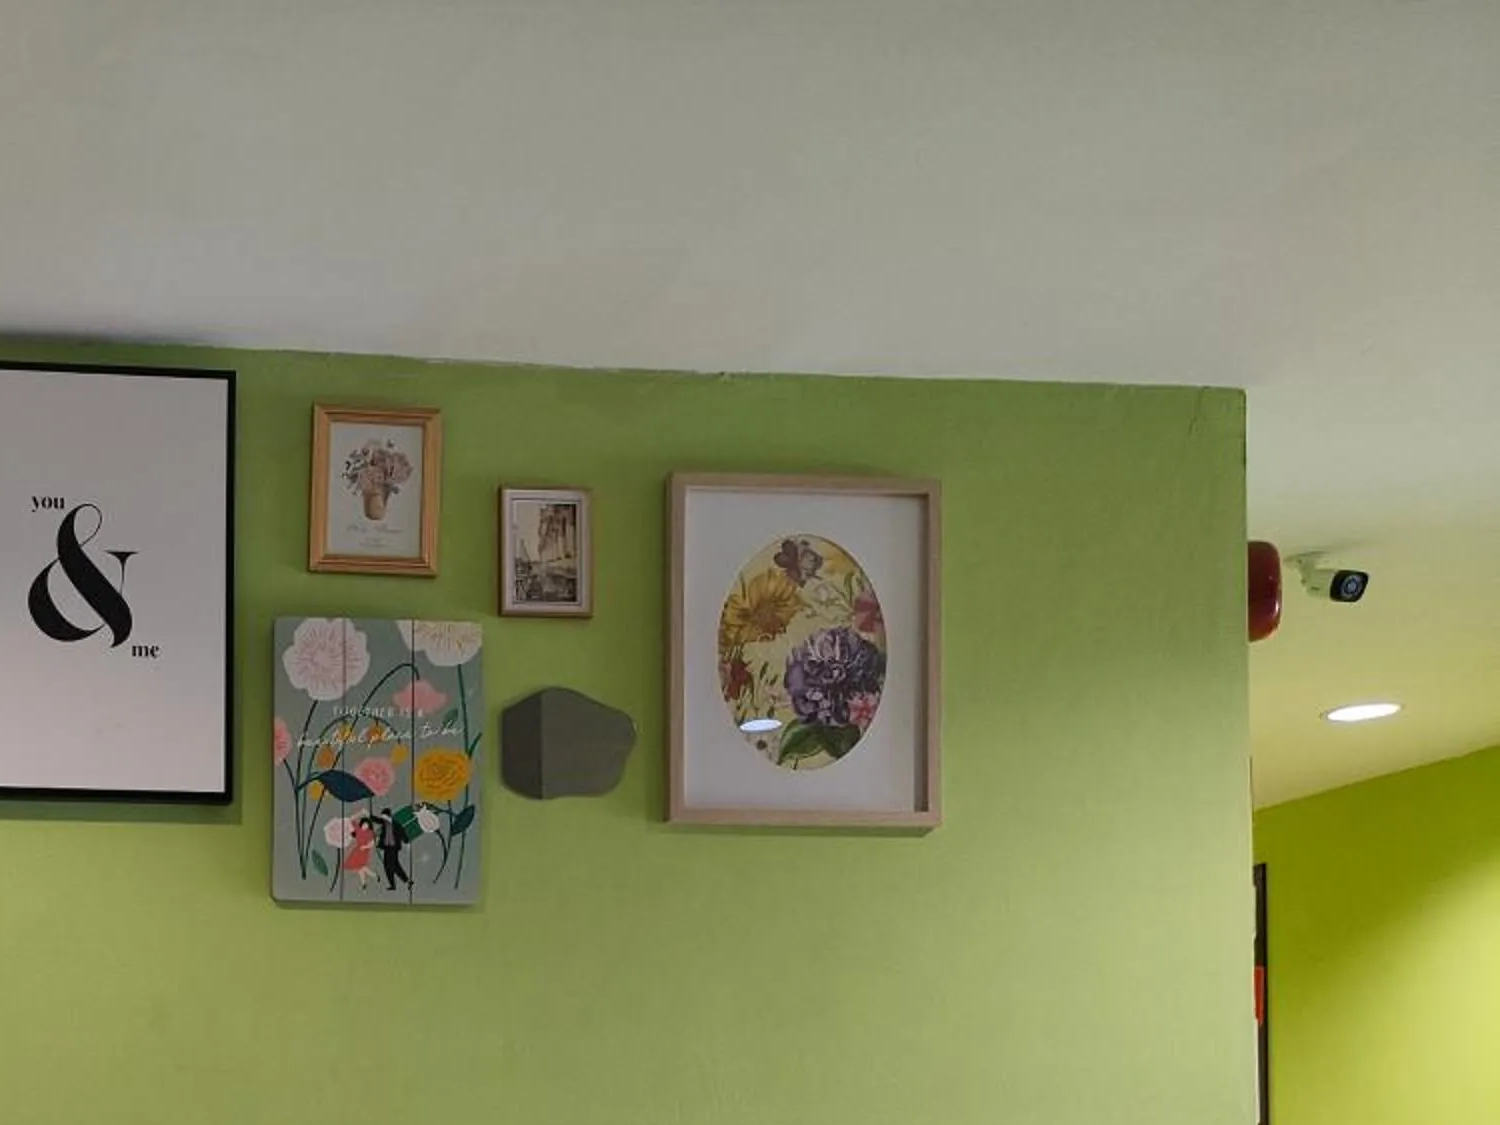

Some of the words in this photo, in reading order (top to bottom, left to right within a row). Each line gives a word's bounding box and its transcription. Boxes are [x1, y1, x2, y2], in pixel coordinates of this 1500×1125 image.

[31, 495, 65, 513] you
[27, 503, 139, 648] &
[131, 645, 160, 658] me
